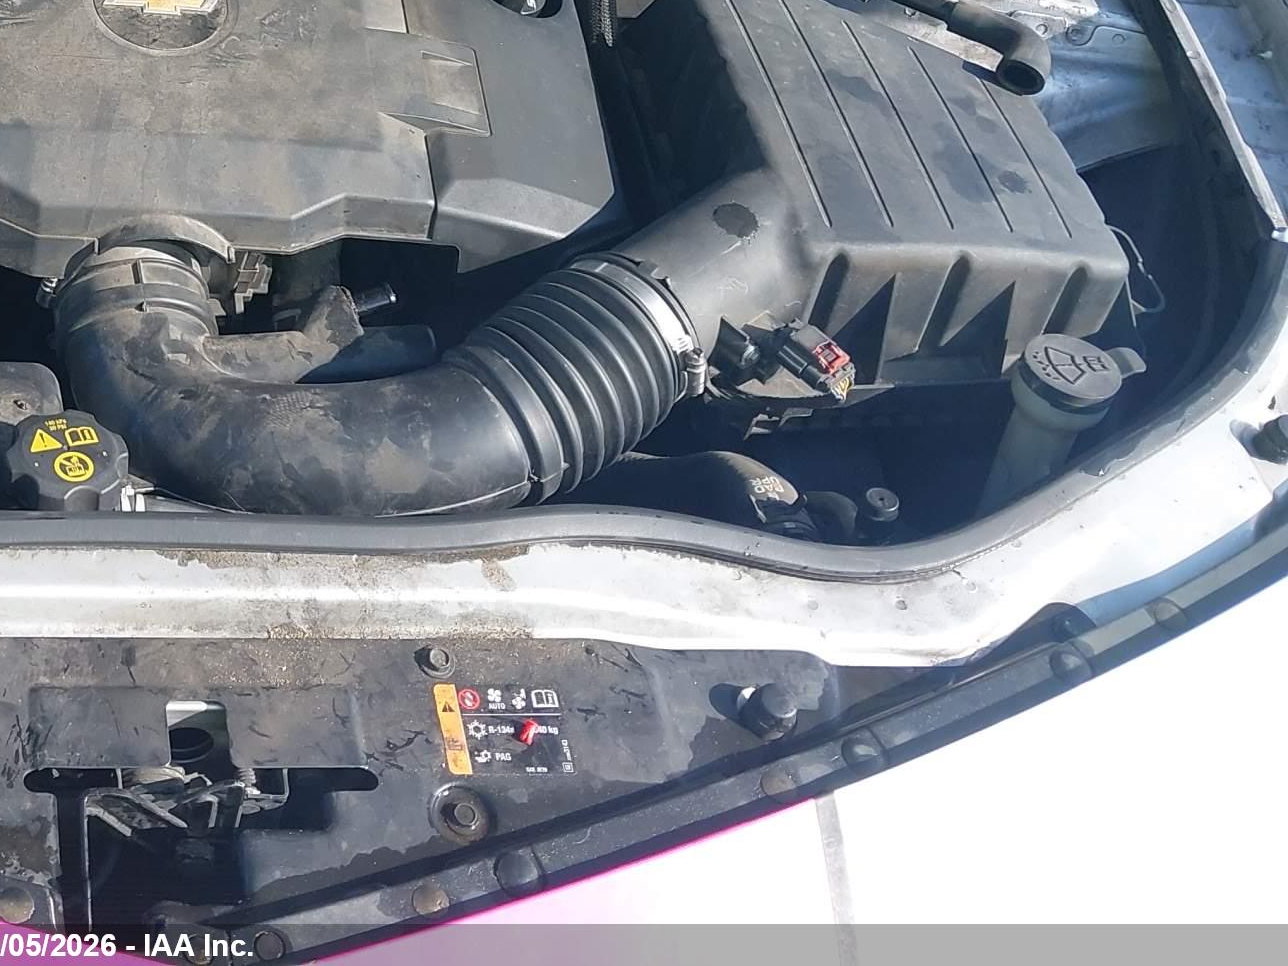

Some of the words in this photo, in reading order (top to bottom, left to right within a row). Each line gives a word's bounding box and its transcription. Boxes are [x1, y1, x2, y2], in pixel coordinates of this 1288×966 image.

[488, 702, 506, 710] AUTO
[548, 725, 559, 735] kg
[495, 752, 512, 761] PAG
